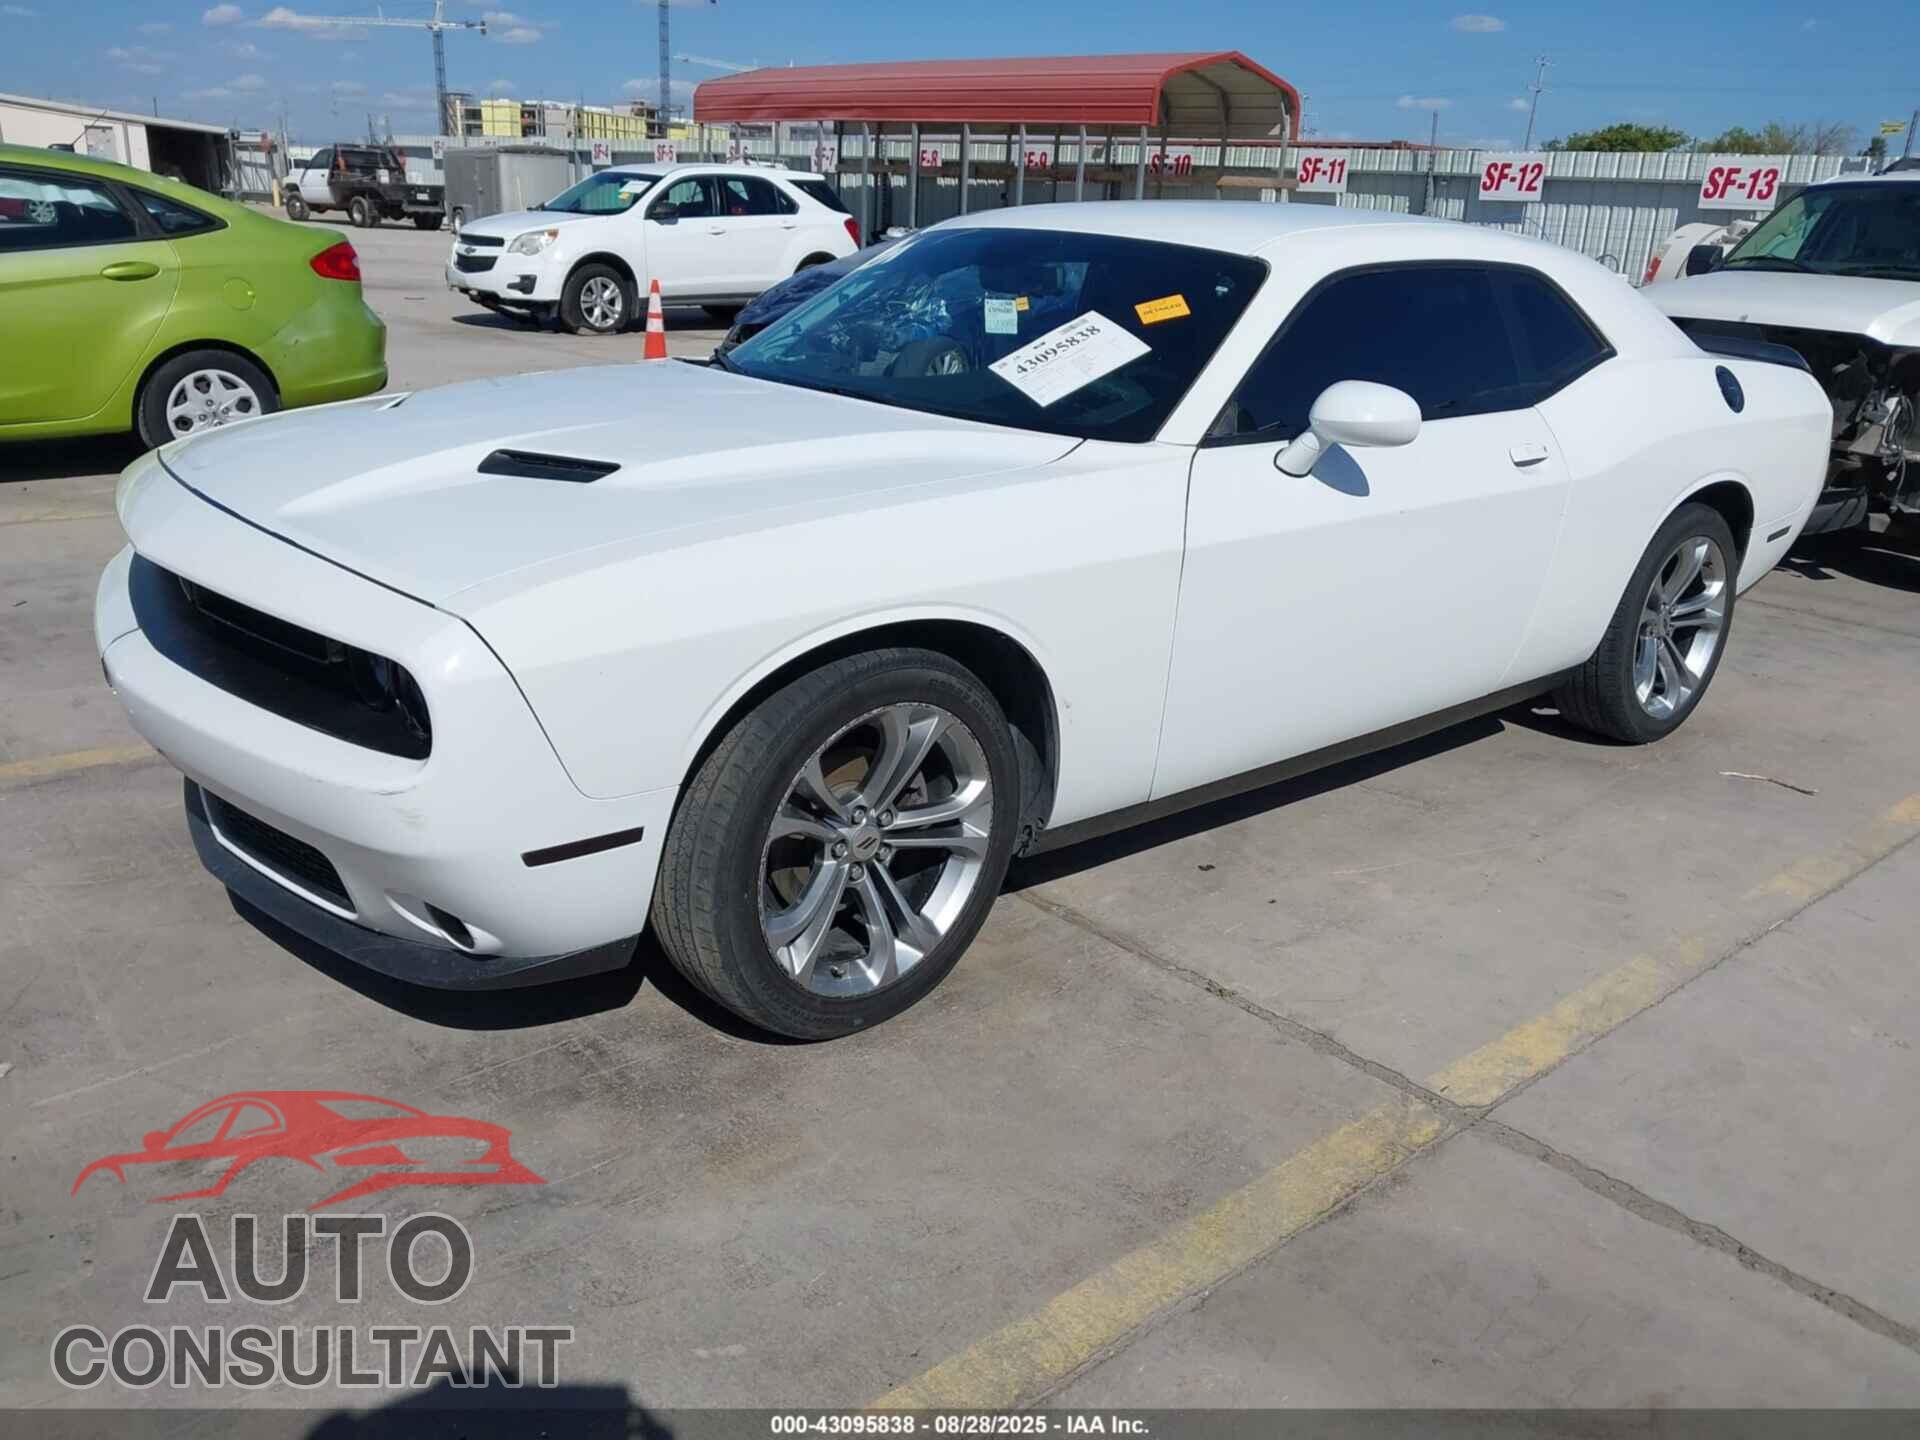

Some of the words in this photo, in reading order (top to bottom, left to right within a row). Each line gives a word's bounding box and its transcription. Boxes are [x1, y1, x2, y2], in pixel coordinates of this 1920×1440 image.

[1300, 157, 1346, 184] SF-11
[1481, 162, 1544, 192] SF-12
[1703, 166, 1779, 201] SF-13
[1016, 325, 1101, 374] 43095838
